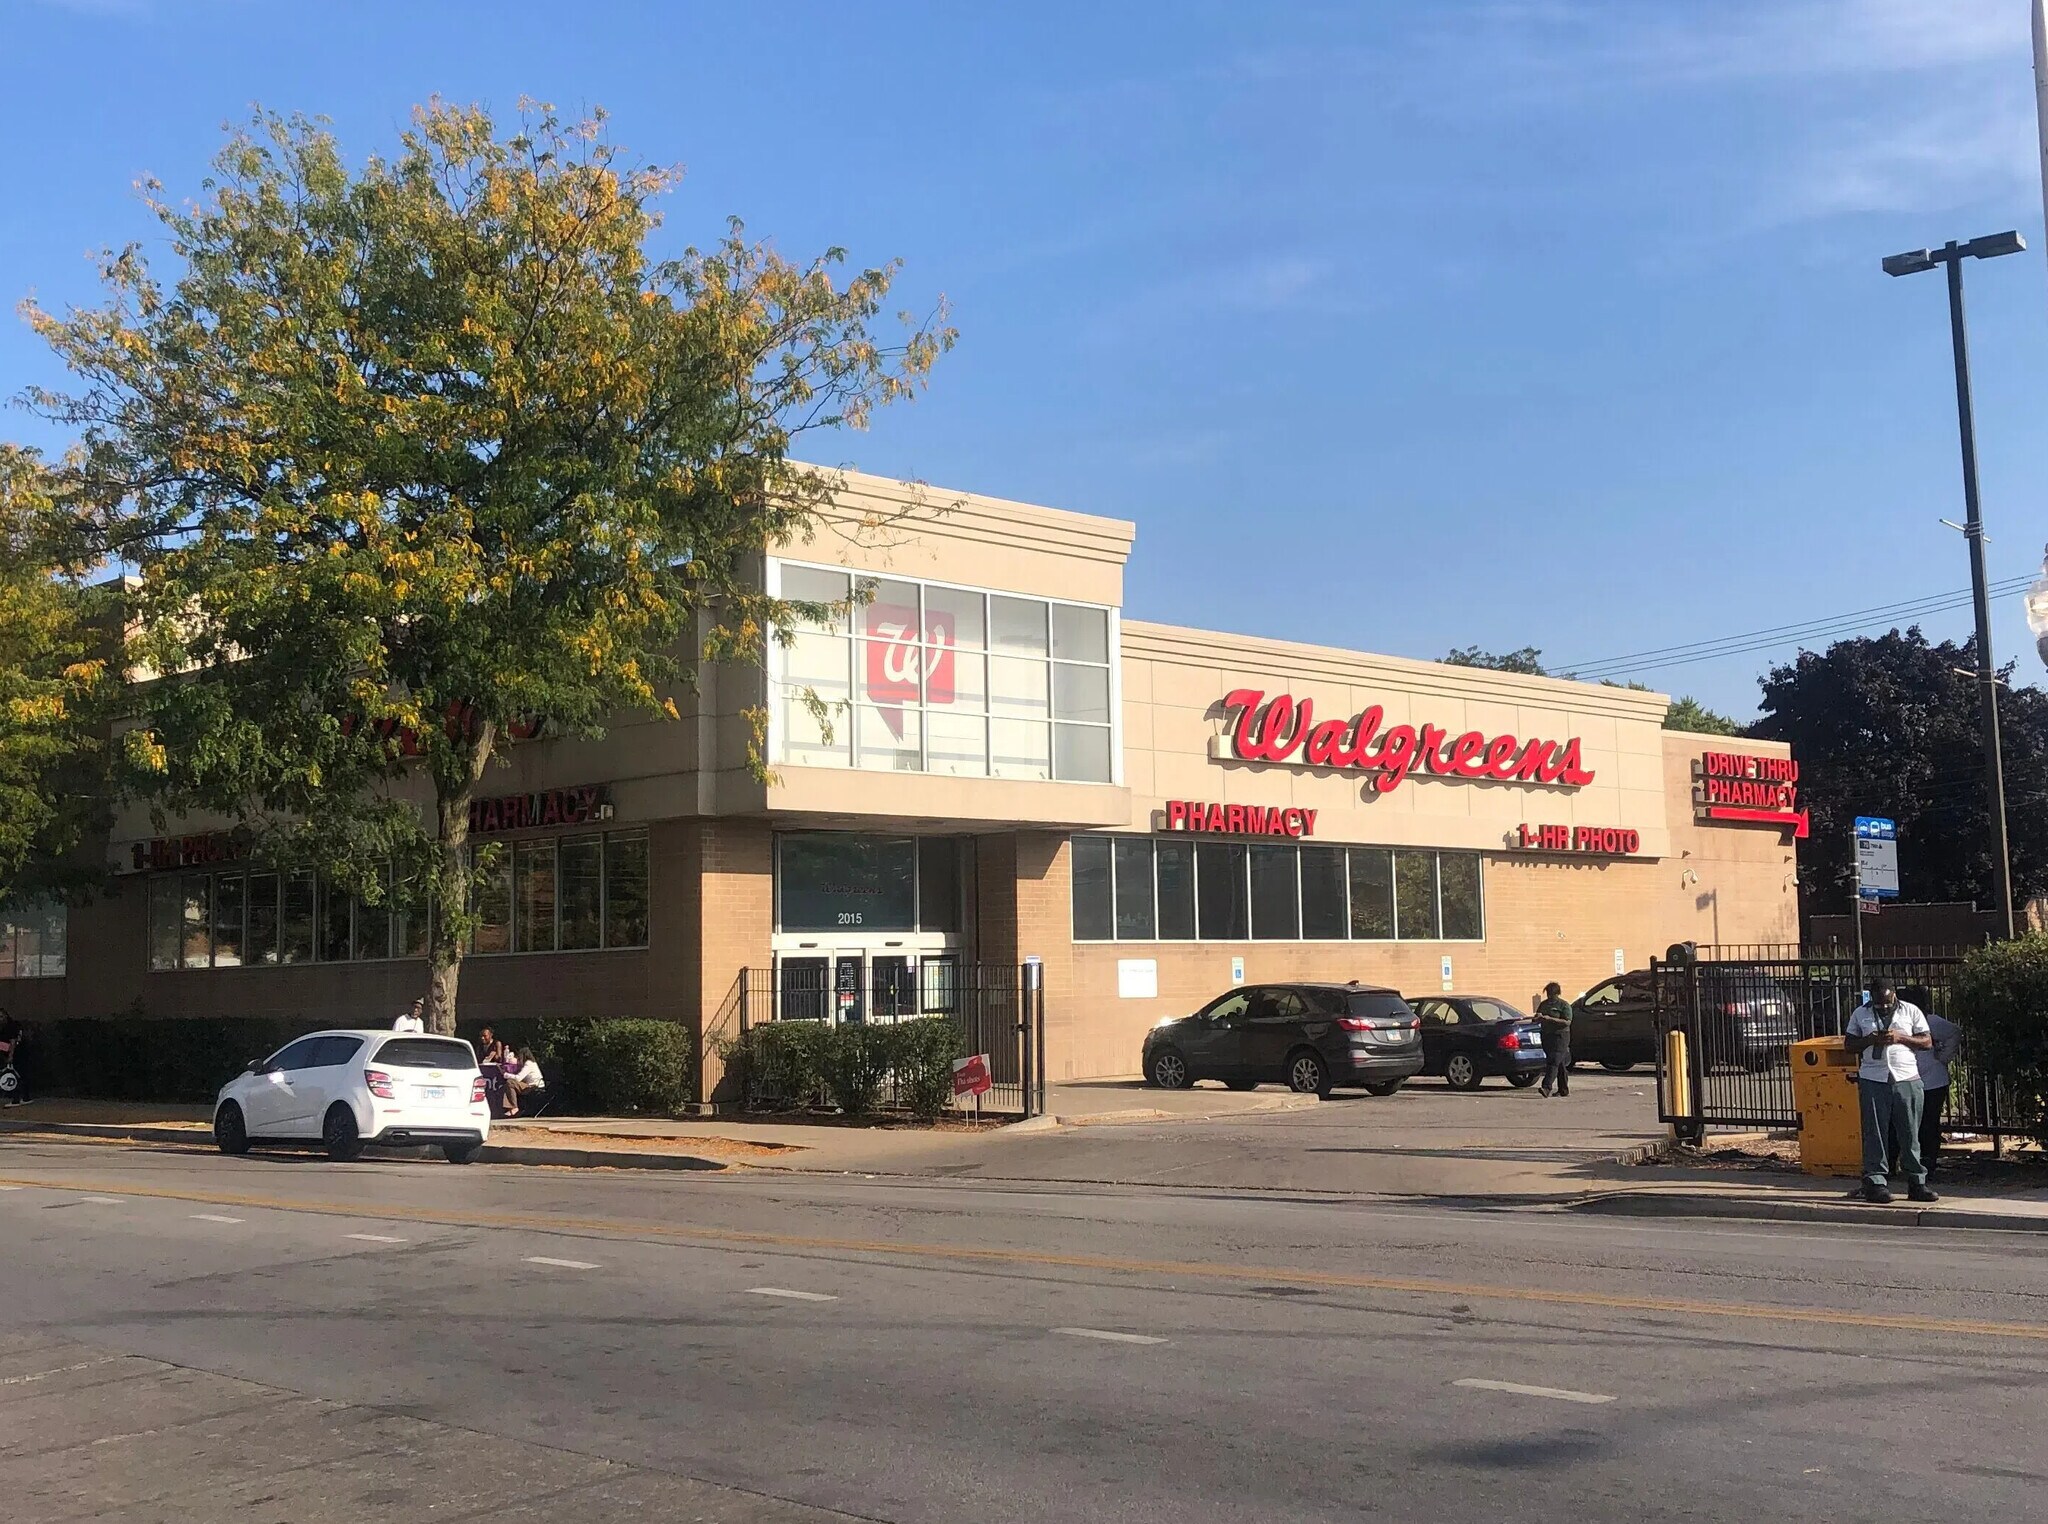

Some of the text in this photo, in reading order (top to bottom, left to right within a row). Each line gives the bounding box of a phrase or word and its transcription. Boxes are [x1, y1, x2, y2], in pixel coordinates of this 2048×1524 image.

[1226, 689, 1595, 792] Walgreens
[1706, 752, 1799, 782] DRIVE THRU
[1708, 779, 1798, 808] PHARMACY
[469, 786, 597, 832] HARMACY
[1168, 801, 1318, 837] PHARMACY
[1518, 823, 1640, 853] 1-HR PHOTO
[1881, 822, 1892, 830] bus
[838, 912, 863, 924] 2015
